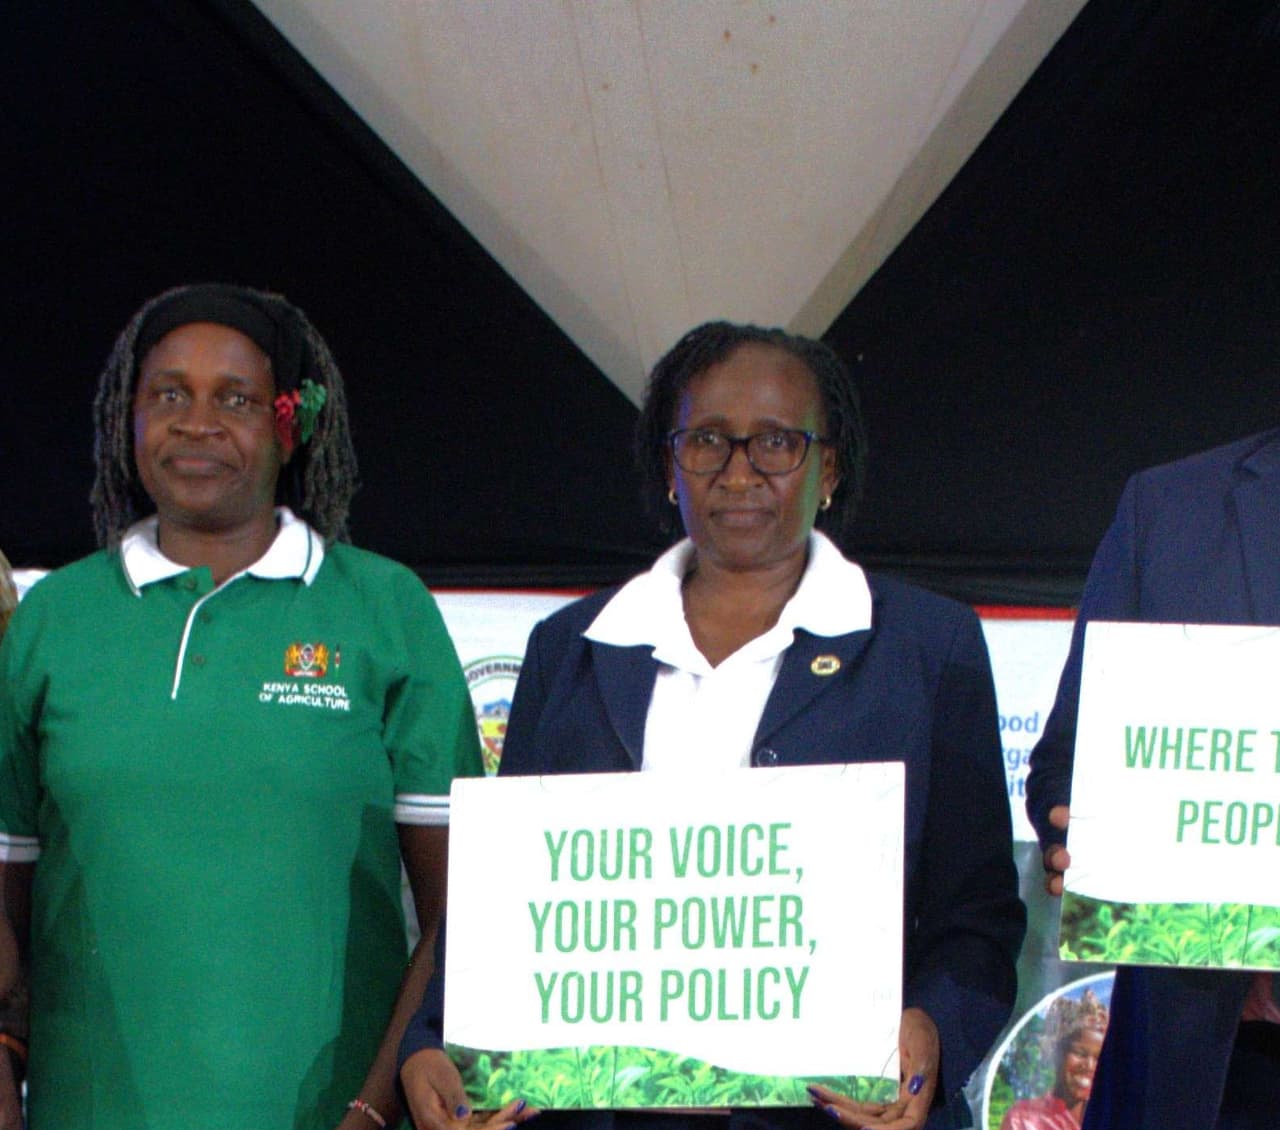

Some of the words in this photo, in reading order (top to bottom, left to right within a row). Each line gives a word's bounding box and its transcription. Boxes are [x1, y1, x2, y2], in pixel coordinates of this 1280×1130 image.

[259, 692, 273, 702] OF
[278, 693, 350, 711] AGRICULTURE
[263, 683, 299, 693] KENYA
[303, 683, 347, 697] SCHOOL
[999, 710, 1039, 734] ood
[1124, 726, 1258, 773] WHERE
[543, 827, 653, 882] YOUR
[669, 822, 805, 883] VOICE,
[528, 899, 637, 953] YOUR
[653, 894, 817, 956] POWER,
[533, 970, 644, 1024] YOUR
[659, 965, 811, 1022] POLICY
